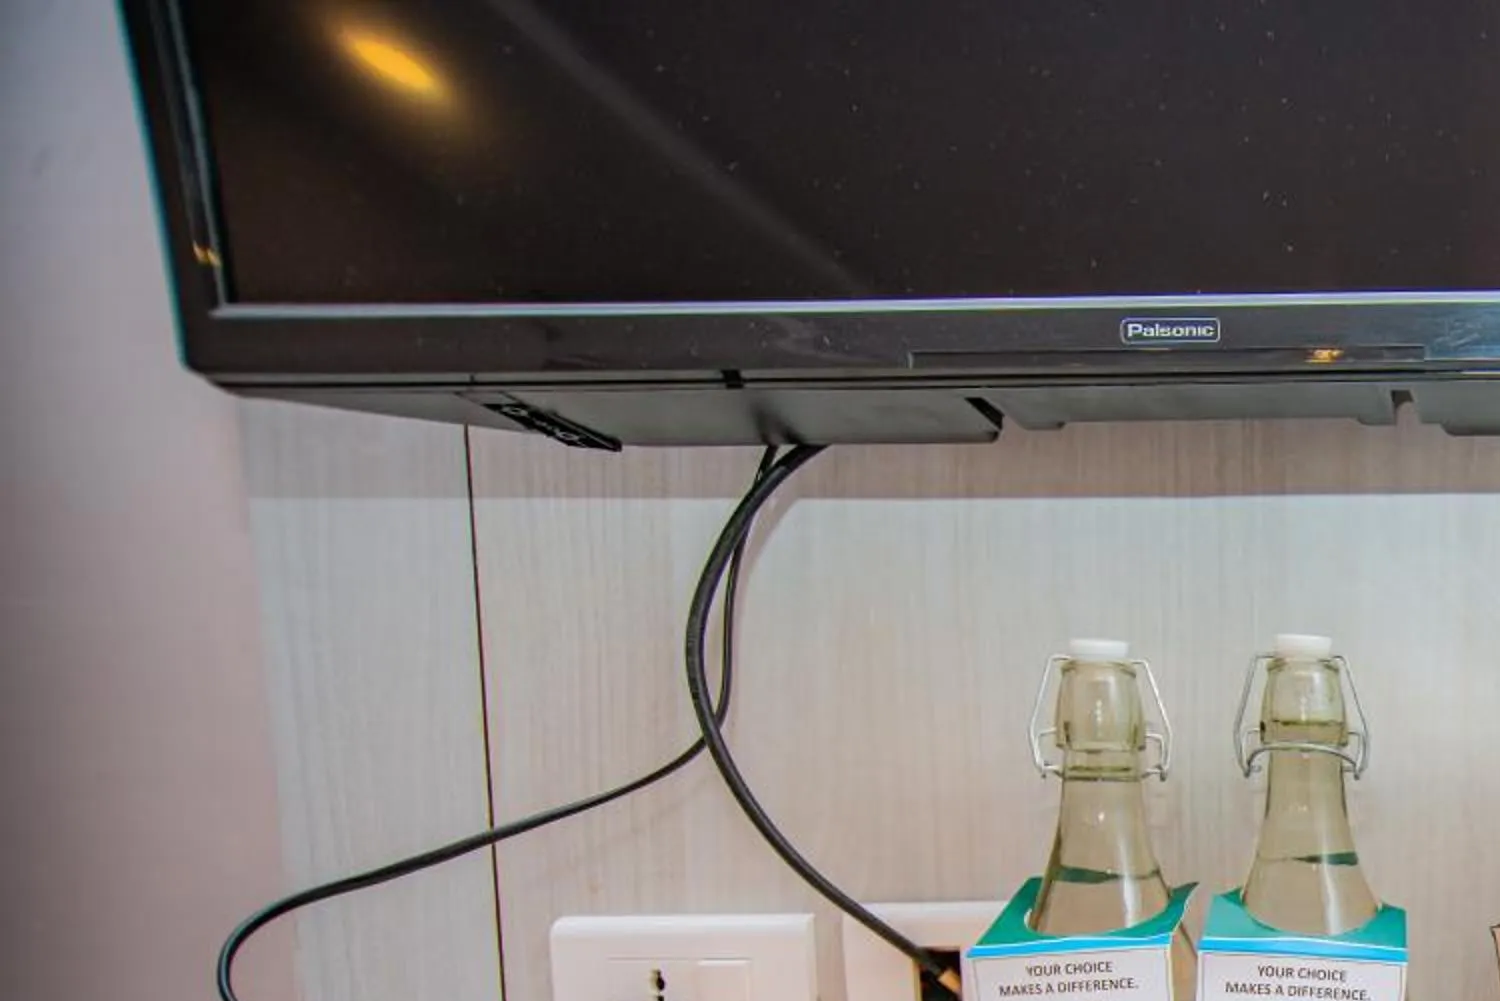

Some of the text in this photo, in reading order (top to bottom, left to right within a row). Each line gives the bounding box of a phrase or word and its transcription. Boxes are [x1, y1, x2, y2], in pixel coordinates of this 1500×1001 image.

[1127, 323, 1214, 337] Palsonic
[1025, 961, 1113, 977] YOUR CHOICE
[1258, 965, 1347, 982] YOUR CHOICE
[999, 978, 1139, 996] MAKES A DIFFERENCE.
[1225, 982, 1371, 1001] MAKES A DIFFERENCE.
